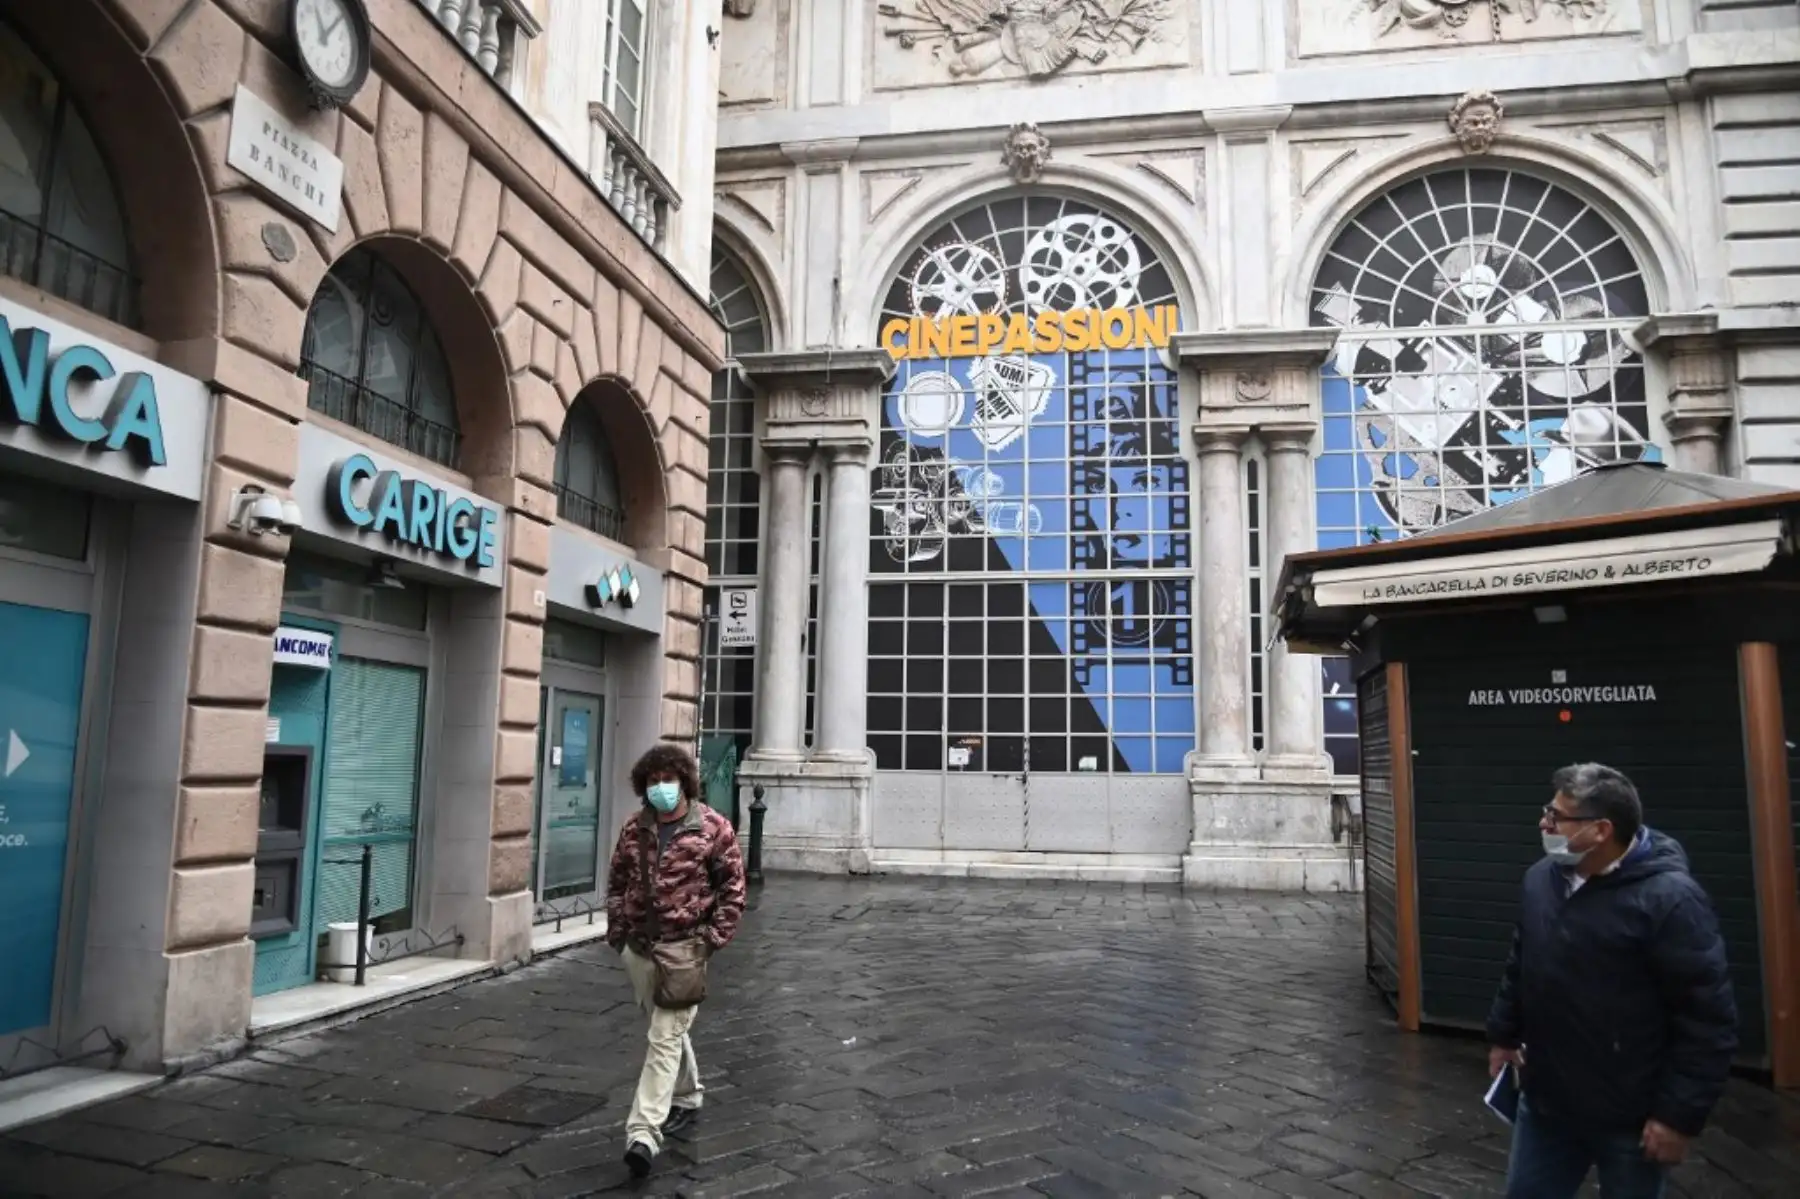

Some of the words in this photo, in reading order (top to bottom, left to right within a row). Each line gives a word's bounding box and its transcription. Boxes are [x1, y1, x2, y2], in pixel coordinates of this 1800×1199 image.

[262, 121, 318, 172] PIAZZA
[249, 143, 325, 207] BANCHI
[881, 304, 1178, 360] CINEPASSIONI
[336, 452, 498, 568] CARIGE
[1363, 587, 1380, 599] LA
[1386, 577, 1486, 598] BANCARELLA
[1492, 575, 1508, 588] DI
[1512, 567, 1598, 586] SEVERINO
[1604, 565, 1616, 579] &
[1622, 557, 1712, 578] ALBERTO
[1468, 689, 1505, 706] AREA
[1508, 685, 1657, 704] VIDEOSORVEGLIATA
